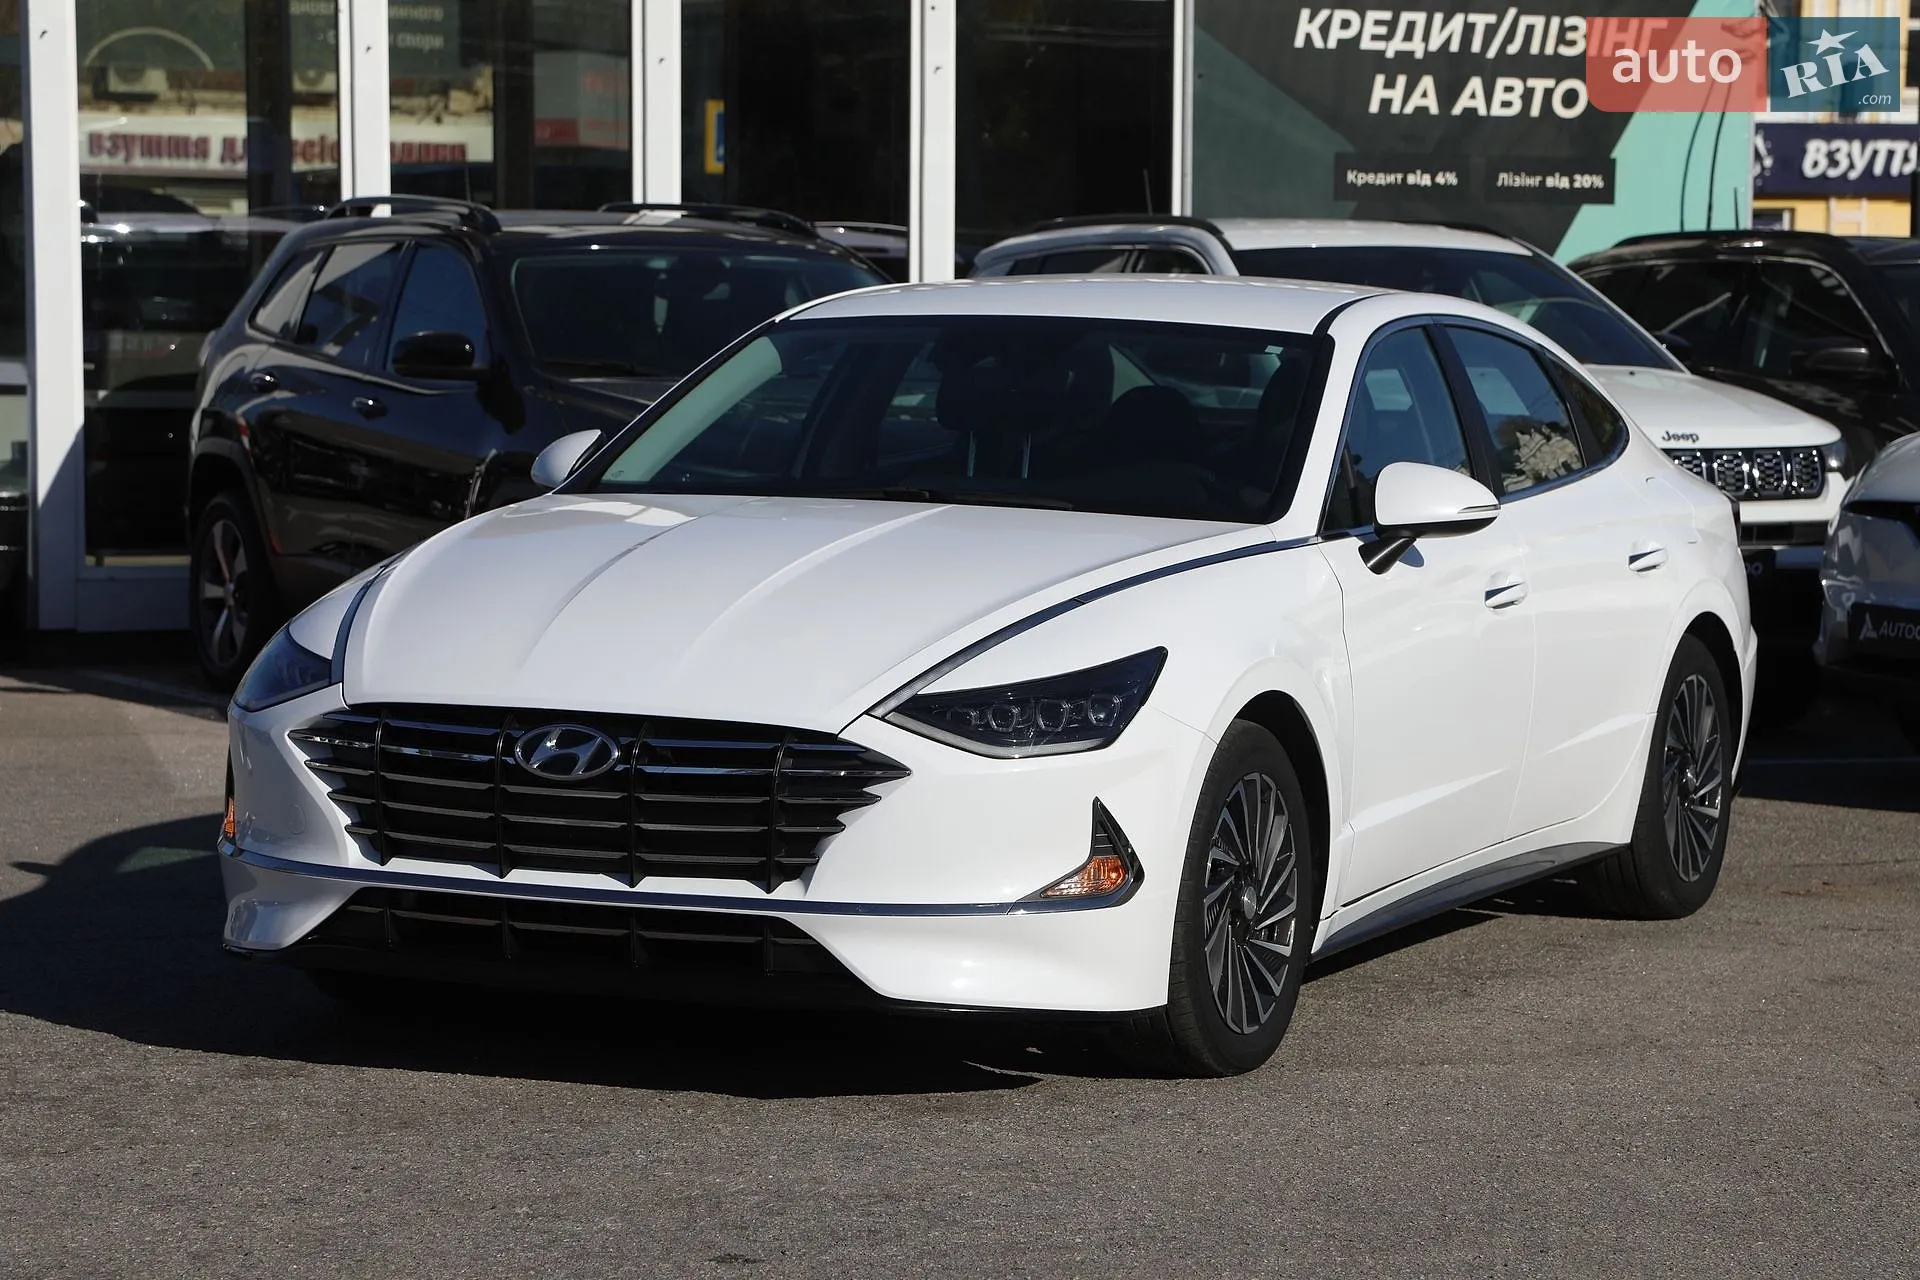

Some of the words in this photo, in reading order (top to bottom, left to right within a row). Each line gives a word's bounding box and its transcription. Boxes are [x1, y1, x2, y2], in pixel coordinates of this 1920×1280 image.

[1368, 74, 1440, 115] НА
[1450, 76, 1589, 119] АВТО
[1346, 169, 1403, 187] Кредит
[1406, 169, 1431, 187] від
[1434, 170, 1458, 186] 4%
[1496, 171, 1543, 188] Лізінг
[1545, 172, 1570, 189] від
[1573, 173, 1604, 189] 20%
[1661, 430, 1700, 443] Jeep
